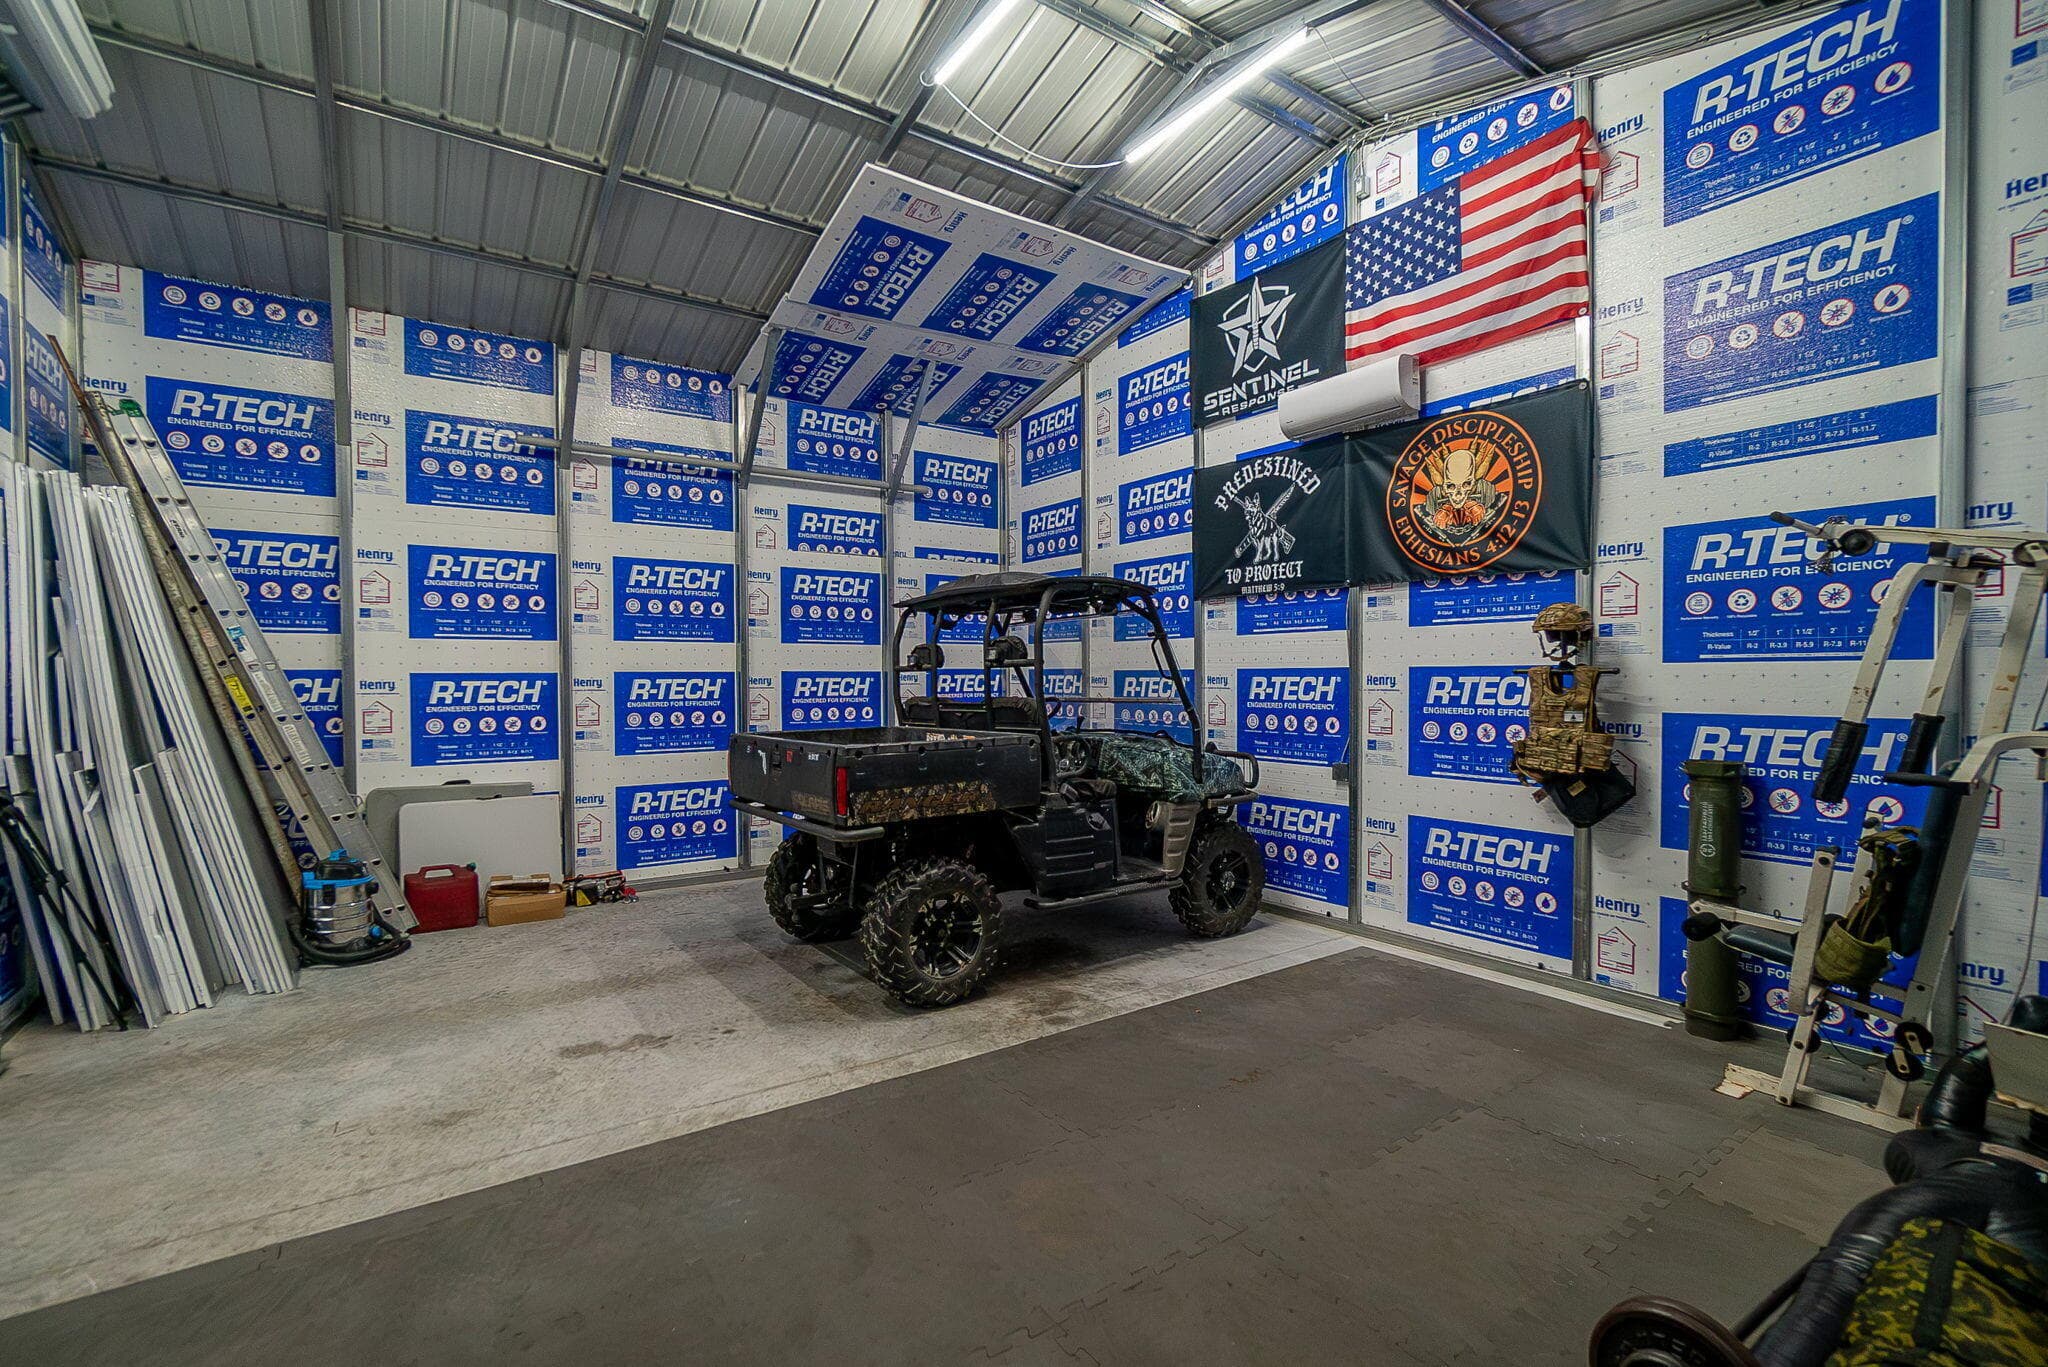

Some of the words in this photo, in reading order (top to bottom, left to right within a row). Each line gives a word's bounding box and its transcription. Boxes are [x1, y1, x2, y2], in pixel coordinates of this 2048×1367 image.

[1690, 0, 1902, 125] R-TECH
[1686, 98, 1770, 140] ENGINEERED
[1774, 84, 1804, 102] FOR
[1806, 42, 1900, 90] EFFICIENCY
[1431, 110, 1486, 144] ENGINEERED
[1598, 113, 1645, 143] Henry
[944, 211, 968, 233] Henry
[1244, 217, 1281, 240] ENGINEERED
[1281, 209, 1295, 222] FOR
[1295, 191, 1333, 215] EFFICIENCY
[1052, 246, 1078, 266] Henry
[1690, 217, 1902, 315] R-TECH
[872, 246, 935, 314] R-TECH
[1145, 275, 1170, 292] Henry
[975, 276, 1040, 334] R-TECH
[1687, 300, 1770, 330] ENGINEERED
[1774, 289, 1804, 306] FOR
[1806, 263, 1899, 298] EFFICIENCY
[1597, 296, 1644, 321] Henry
[1066, 299, 1130, 351] R-TECH
[803, 349, 853, 398] R-TECH
[1127, 356, 1191, 401] R-TECH
[1203, 358, 1320, 411] SENTINEL
[980, 383, 1033, 425] R-TECH
[1095, 388, 1112, 401] Henry
[170, 388, 316, 430] R-TECH
[354, 410, 391, 425] Henry
[166, 416, 233, 431] ENGINEERED
[234, 423, 256, 434] FOR
[257, 426, 314, 440] EFFICIENCY
[800, 408, 877, 439] R-TECH
[1027, 404, 1076, 440] R-TECH
[421, 445, 474, 457] ENGINEERED
[474, 451, 492, 459] FOR
[492, 452, 538, 464] EFFICIENCY
[1393, 440, 1431, 508] SAVAGE
[1432, 418, 1534, 490] DISCIPLESHIP
[624, 470, 667, 482] ENGINEERED
[667, 473, 682, 482] FOR
[682, 474, 720, 485] EFFICIENCY
[924, 458, 990, 485] R-TECH
[1127, 473, 1193, 510] R-TECH
[1214, 455, 1321, 511] PREDESTINED
[1096, 493, 1113, 505] Henry
[754, 505, 778, 518] Henry
[1028, 506, 1076, 534] R-TECH
[800, 512, 878, 538] R-TECH
[1395, 516, 1481, 566] EPHESIANS
[1485, 500, 1531, 553] 4:12-13
[357, 548, 394, 562] Henry
[1598, 541, 1644, 559] Henry
[260, 569, 281, 577] FOR
[282, 569, 336, 580] EFFICIENCY
[427, 554, 541, 582] R-TECH
[571, 560, 602, 573] Henry
[628, 564, 722, 590] R-TECH
[747, 571, 771, 582] Henry
[1225, 568, 1242, 585] TO
[1245, 560, 1304, 583] PROTECT
[1686, 567, 1769, 584] ENGINEERED
[1771, 565, 1801, 577] FOR
[423, 579, 476, 589] ENGINEERED
[477, 581, 494, 589] FOR
[494, 582, 540, 591] EFFICIENCY
[626, 587, 668, 596] ENGINEERED
[669, 589, 683, 597] FOR
[683, 589, 720, 598] EFFICIENCY
[793, 574, 871, 597] R-TECH
[897, 577, 918, 587] Henry
[1241, 584, 1273, 595] MATTHEW
[1273, 583, 1286, 592] 5:9
[1702, 631, 1735, 639] Thickness
[1707, 642, 1733, 651] R-Value
[359, 680, 396, 692] Henry
[573, 678, 603, 688] Henry
[748, 676, 772, 687] Henry
[794, 677, 871, 697] R-TECH
[899, 672, 919, 682] Henry
[1091, 676, 1108, 687] Henry
[1206, 675, 1229, 688] Henry
[1366, 674, 1397, 688] Henry
[428, 680, 542, 704] R-TECH
[629, 678, 723, 700] R-TECH
[1250, 676, 1337, 701] R-TECH
[496, 704, 542, 712] EFFICIENCY
[1246, 701, 1284, 709] ENGINEERED
[1284, 702, 1297, 710] FOR
[1297, 702, 1335, 711] EFFICIENCY
[1423, 707, 1476, 716] ENGINEERED
[1476, 707, 1496, 717] FOR
[1770, 768, 1799, 779] FOR
[575, 795, 605, 805] Henry
[631, 786, 724, 814] R-TECH
[629, 813, 671, 821] ENGINEERED
[686, 808, 723, 818] EFFICIENCY
[1250, 801, 1336, 838] R-TECH
[1366, 817, 1397, 833] Henry
[1246, 826, 1283, 838] ENGINEERED
[1283, 831, 1296, 840] FOR
[1297, 835, 1335, 847] EFFICIENCY
[1424, 827, 1553, 874] R-TECH
[1422, 856, 1474, 872] ENGINEERED
[1475, 865, 1495, 876] FOR
[1495, 869, 1551, 885] EFFICIENCY
[1594, 895, 1641, 918] Henry
